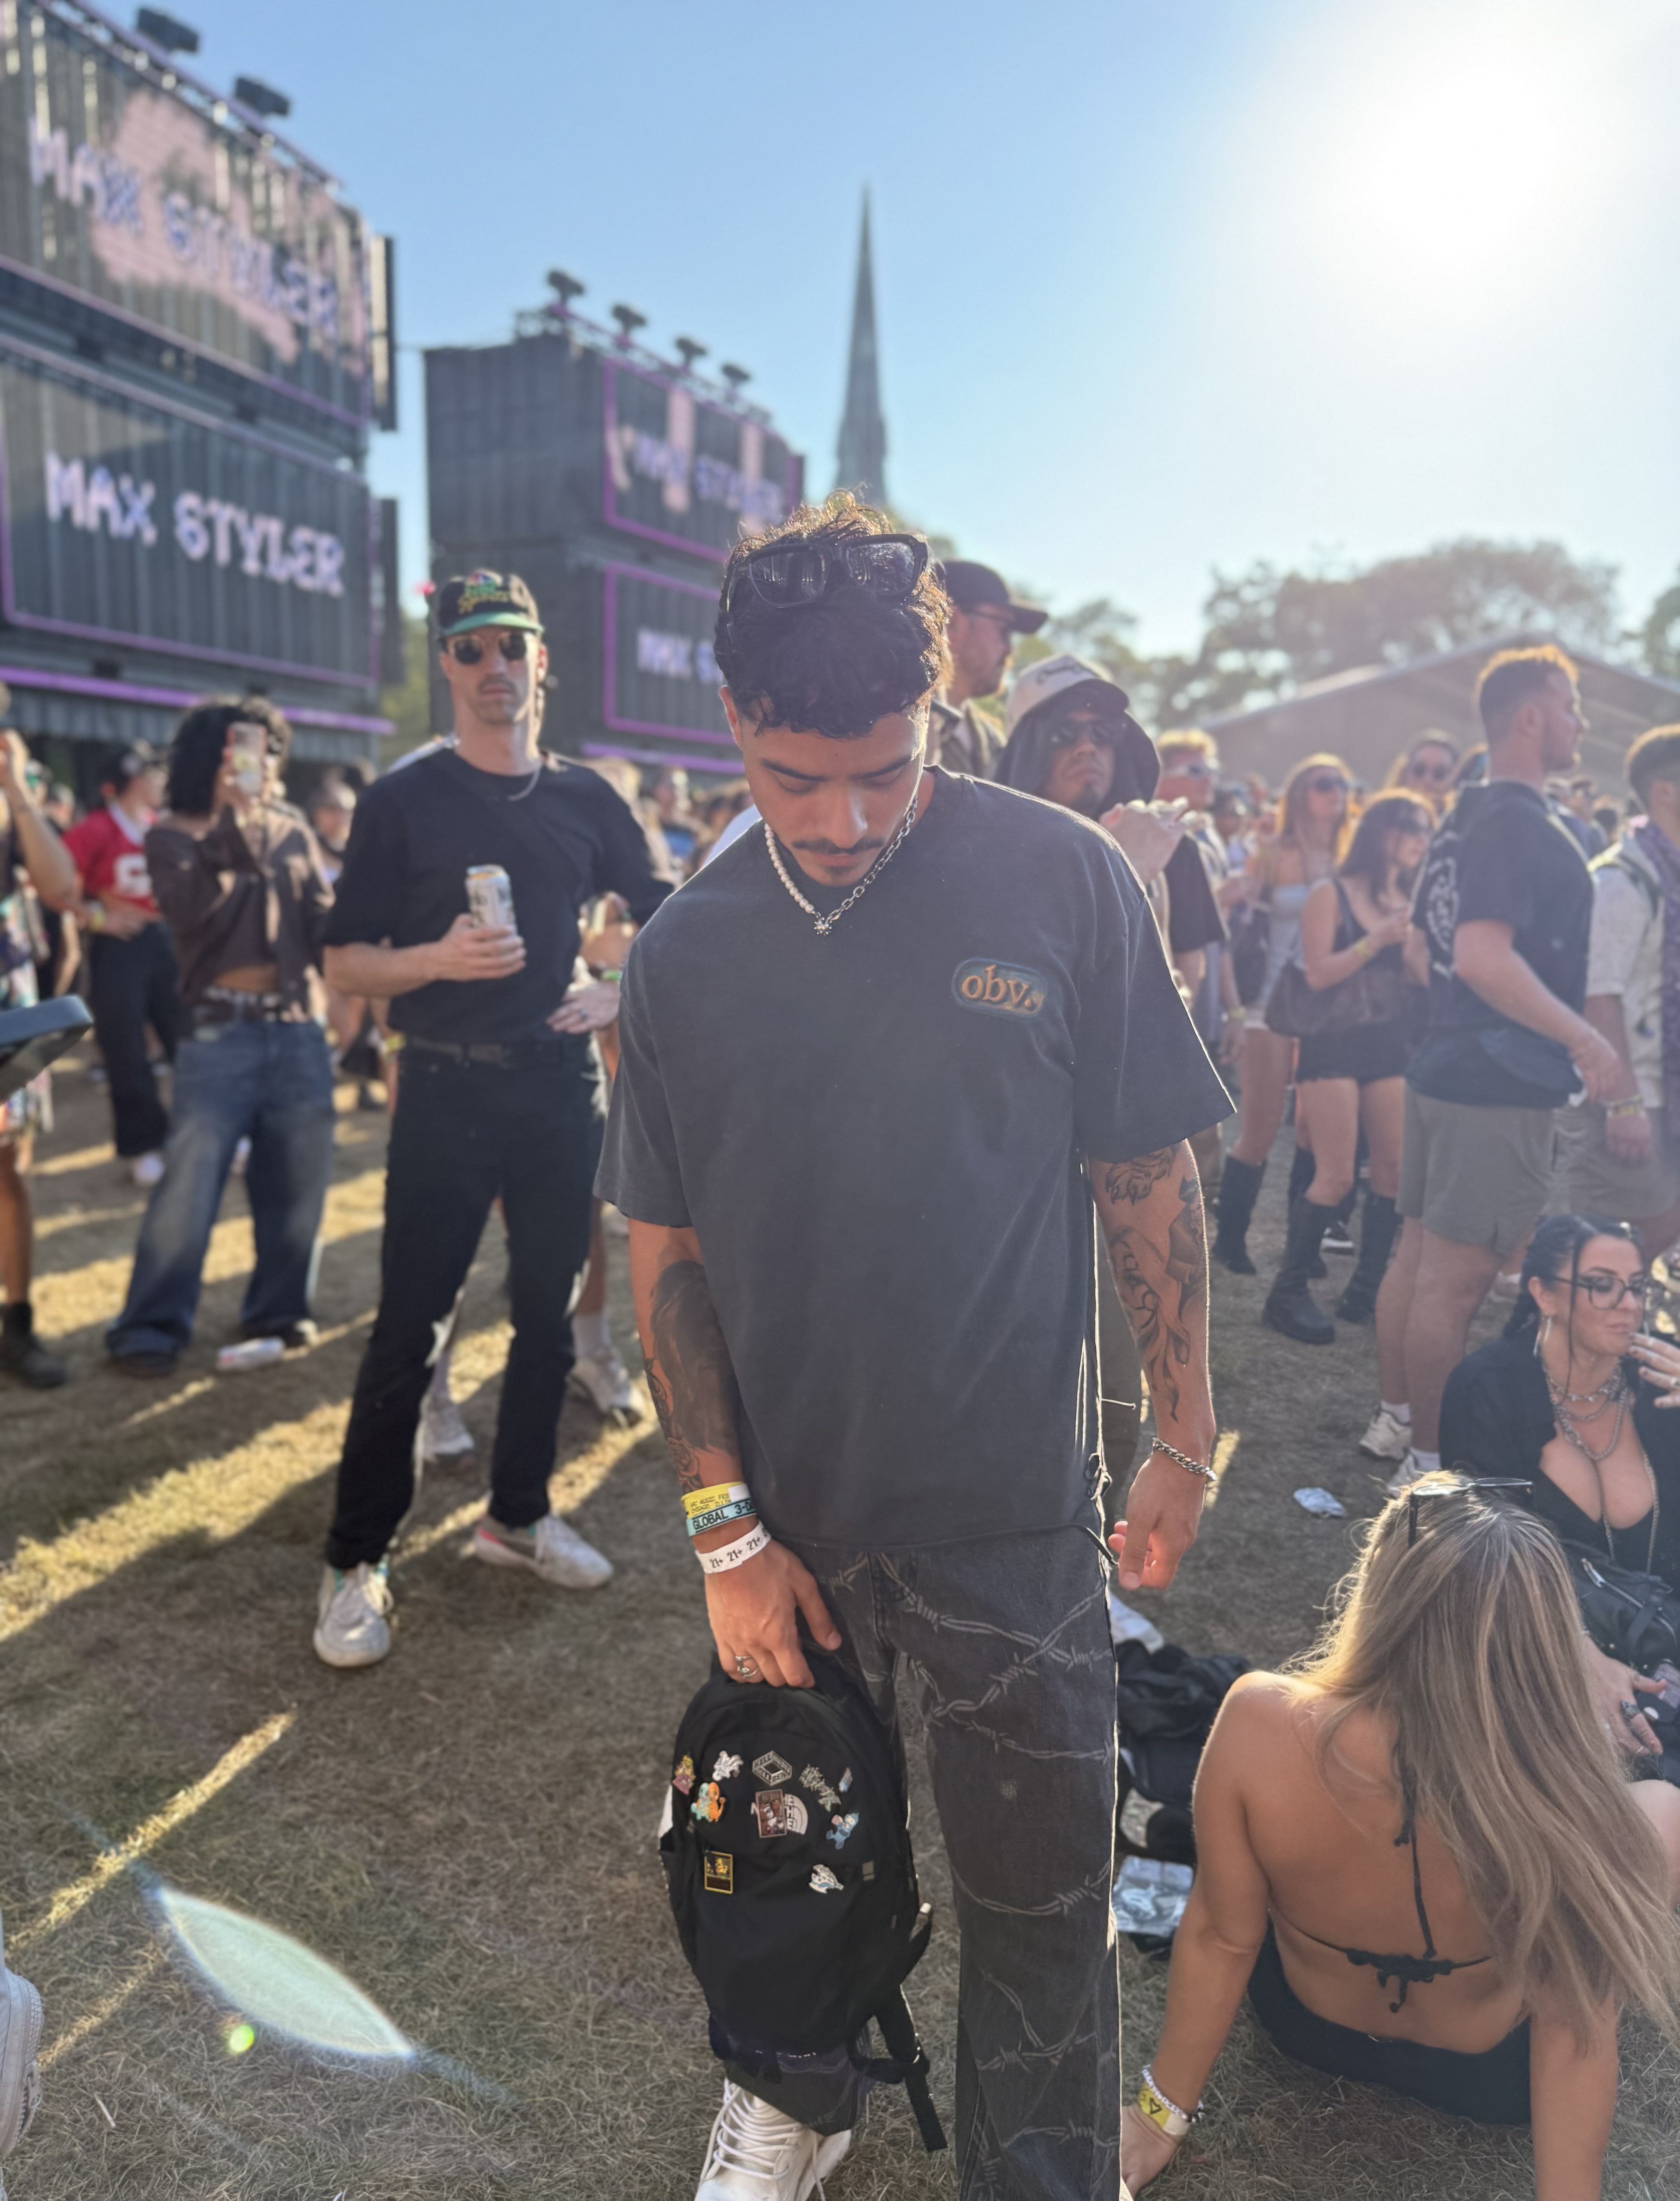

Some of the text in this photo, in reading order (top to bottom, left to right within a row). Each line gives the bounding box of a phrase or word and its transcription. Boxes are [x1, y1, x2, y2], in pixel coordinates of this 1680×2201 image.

[28, 115, 142, 234] MAX
[45, 450, 345, 598] MAX STYLER
[962, 964, 1032, 1007] obv.
[693, 1509, 729, 1530] GLOBAL
[735, 1501, 753, 1514] 3-D
[709, 1536, 761, 1568] 21+ 21+ 21+
[754, 1754, 772, 1768] HELL
